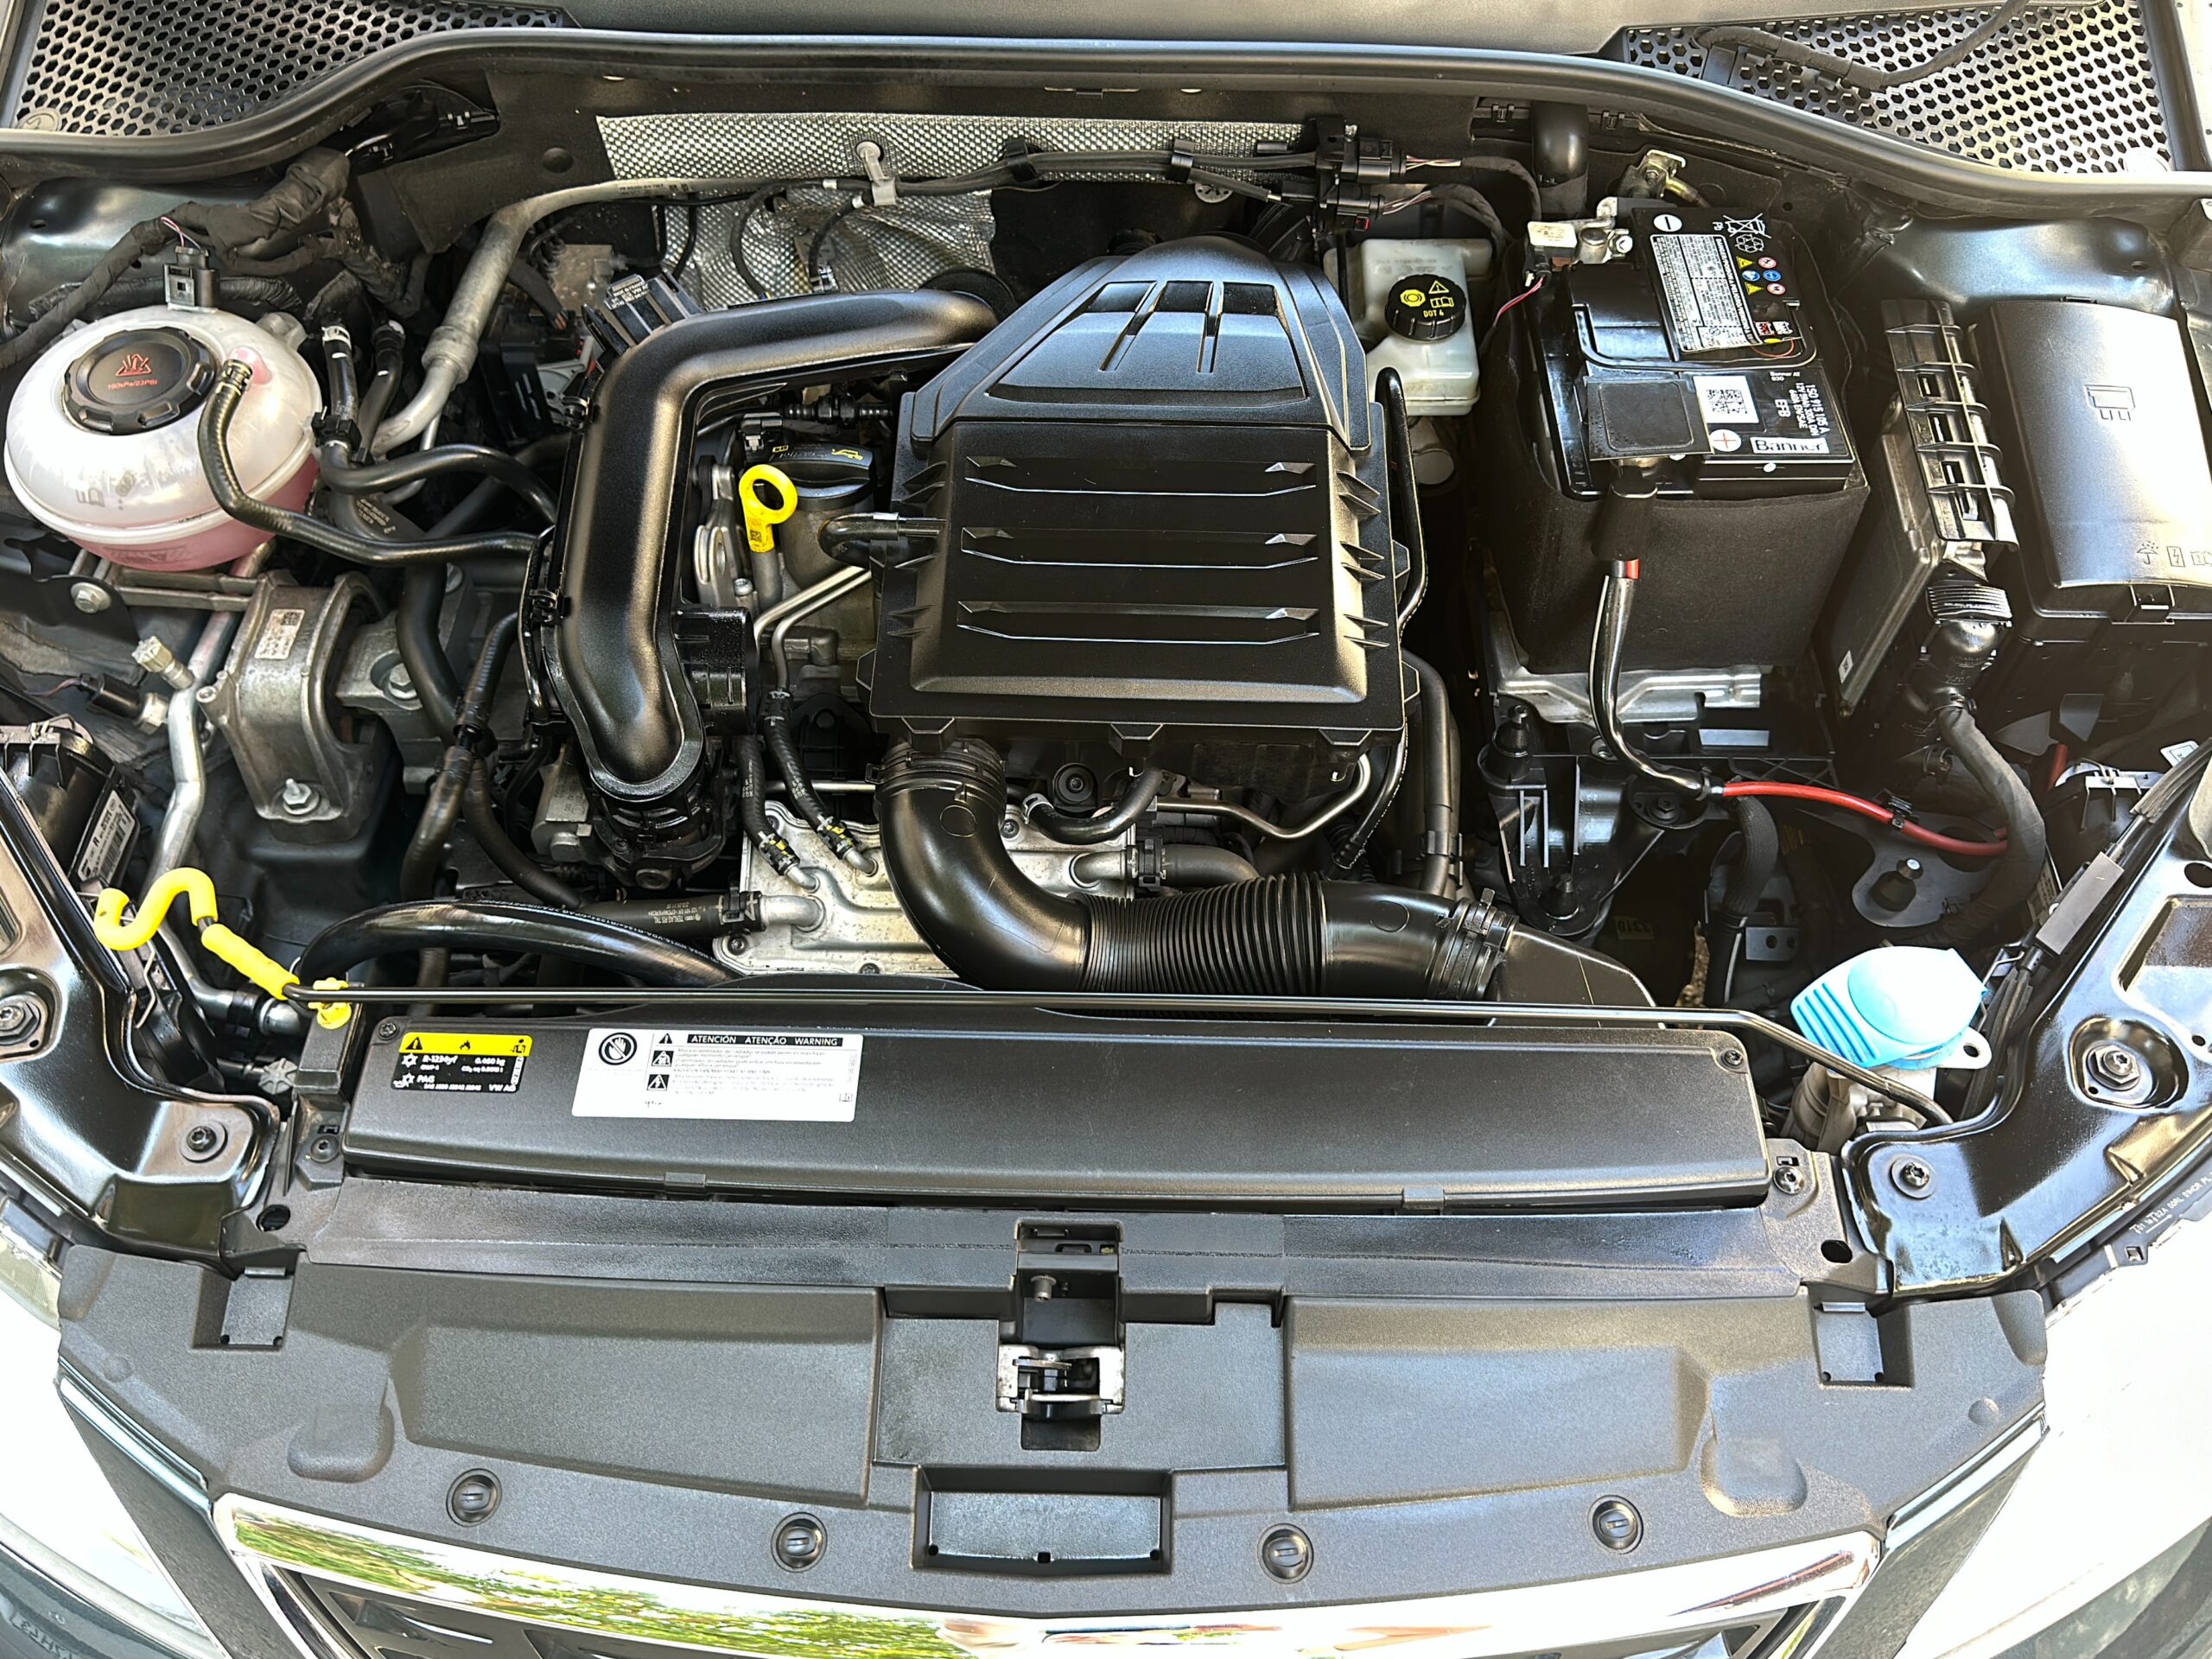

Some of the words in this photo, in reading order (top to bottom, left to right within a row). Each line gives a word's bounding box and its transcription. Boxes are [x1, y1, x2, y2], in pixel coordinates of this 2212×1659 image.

[1422, 309, 1437, 318] DOT
[1774, 399, 1791, 417] EFB
[1755, 440, 1822, 451] Banner
[691, 1034, 736, 1044] ATENCIÓN
[745, 1034, 787, 1046] ATENÇÃO
[794, 1037, 838, 1046] WARNING
[422, 1054, 459, 1065] R-1234yf
[416, 1075, 435, 1084] PAG
